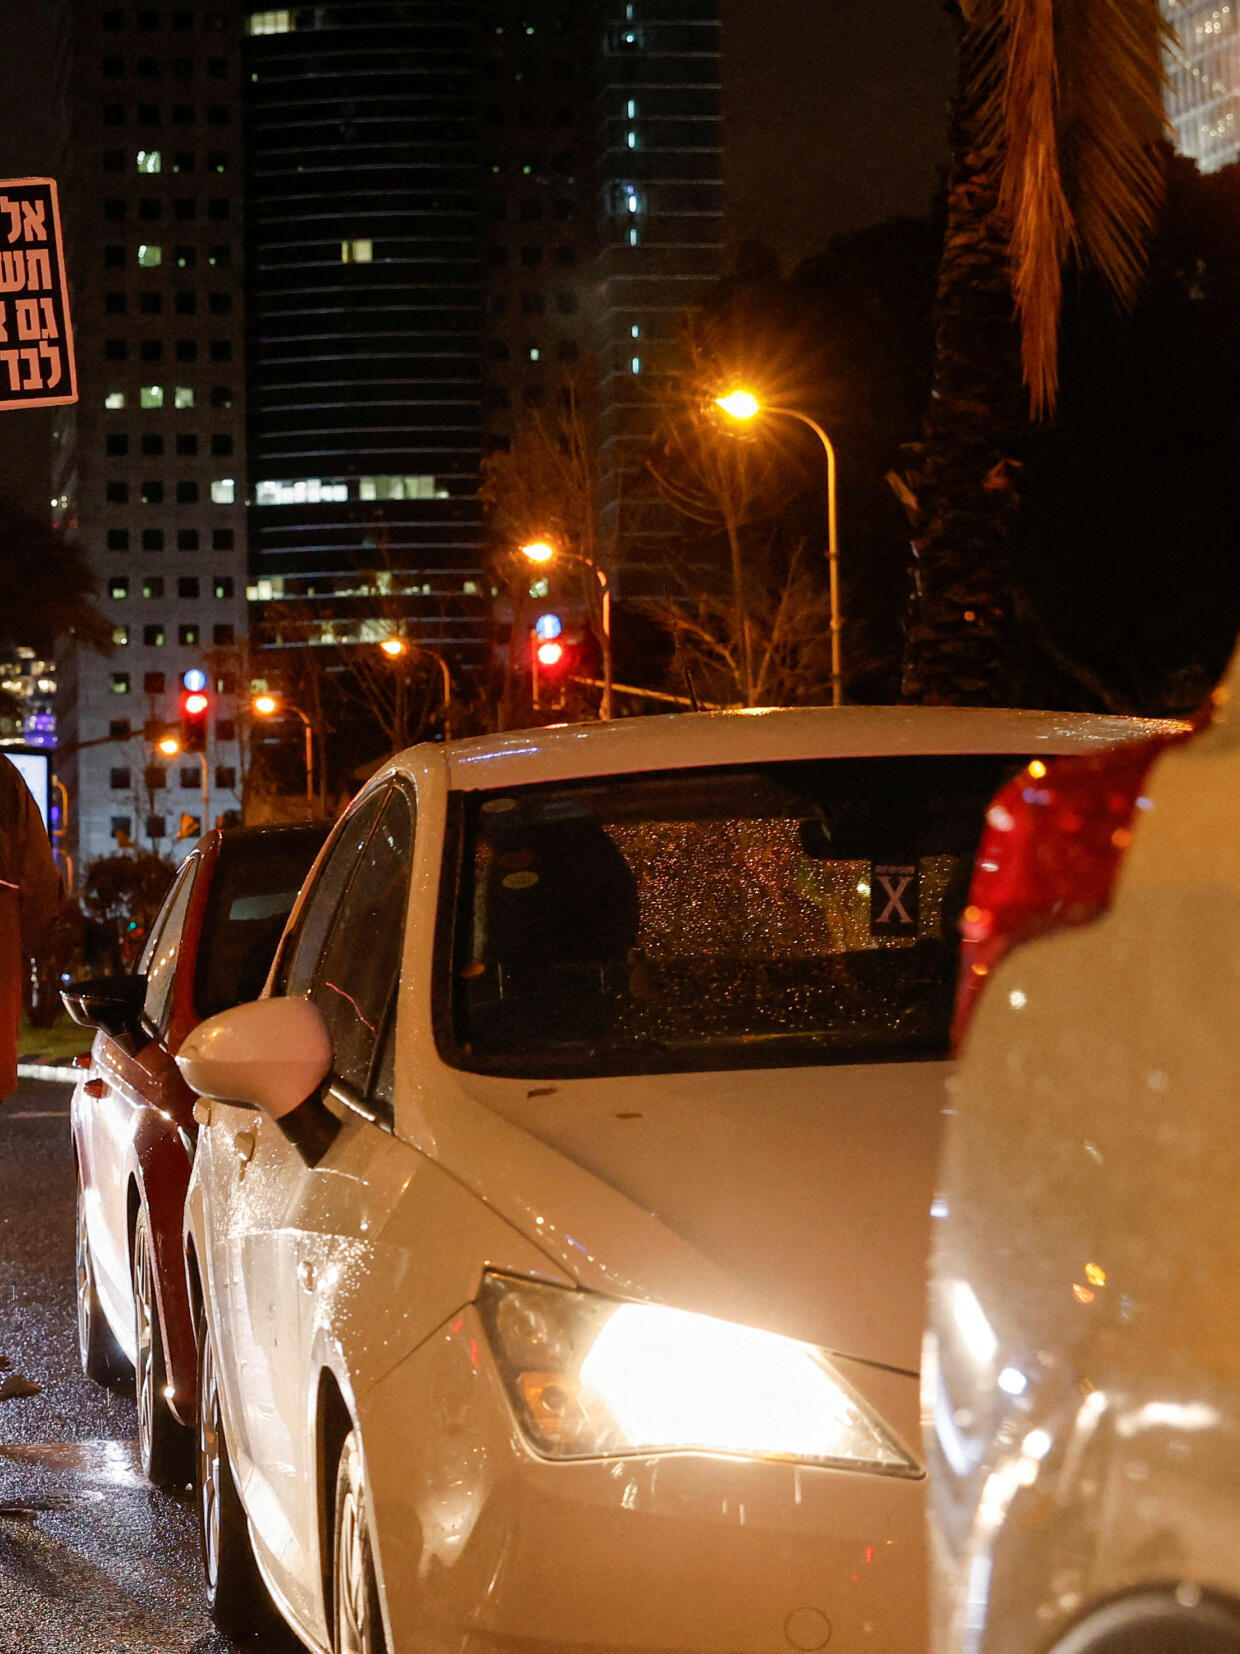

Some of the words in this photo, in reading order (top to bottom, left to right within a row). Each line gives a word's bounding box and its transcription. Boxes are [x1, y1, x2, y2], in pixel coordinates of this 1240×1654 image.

[0, 195, 48, 244] אל
[15, 297, 59, 341] גם
[0, 340, 62, 391] לבד
[875, 875, 914, 923] X
